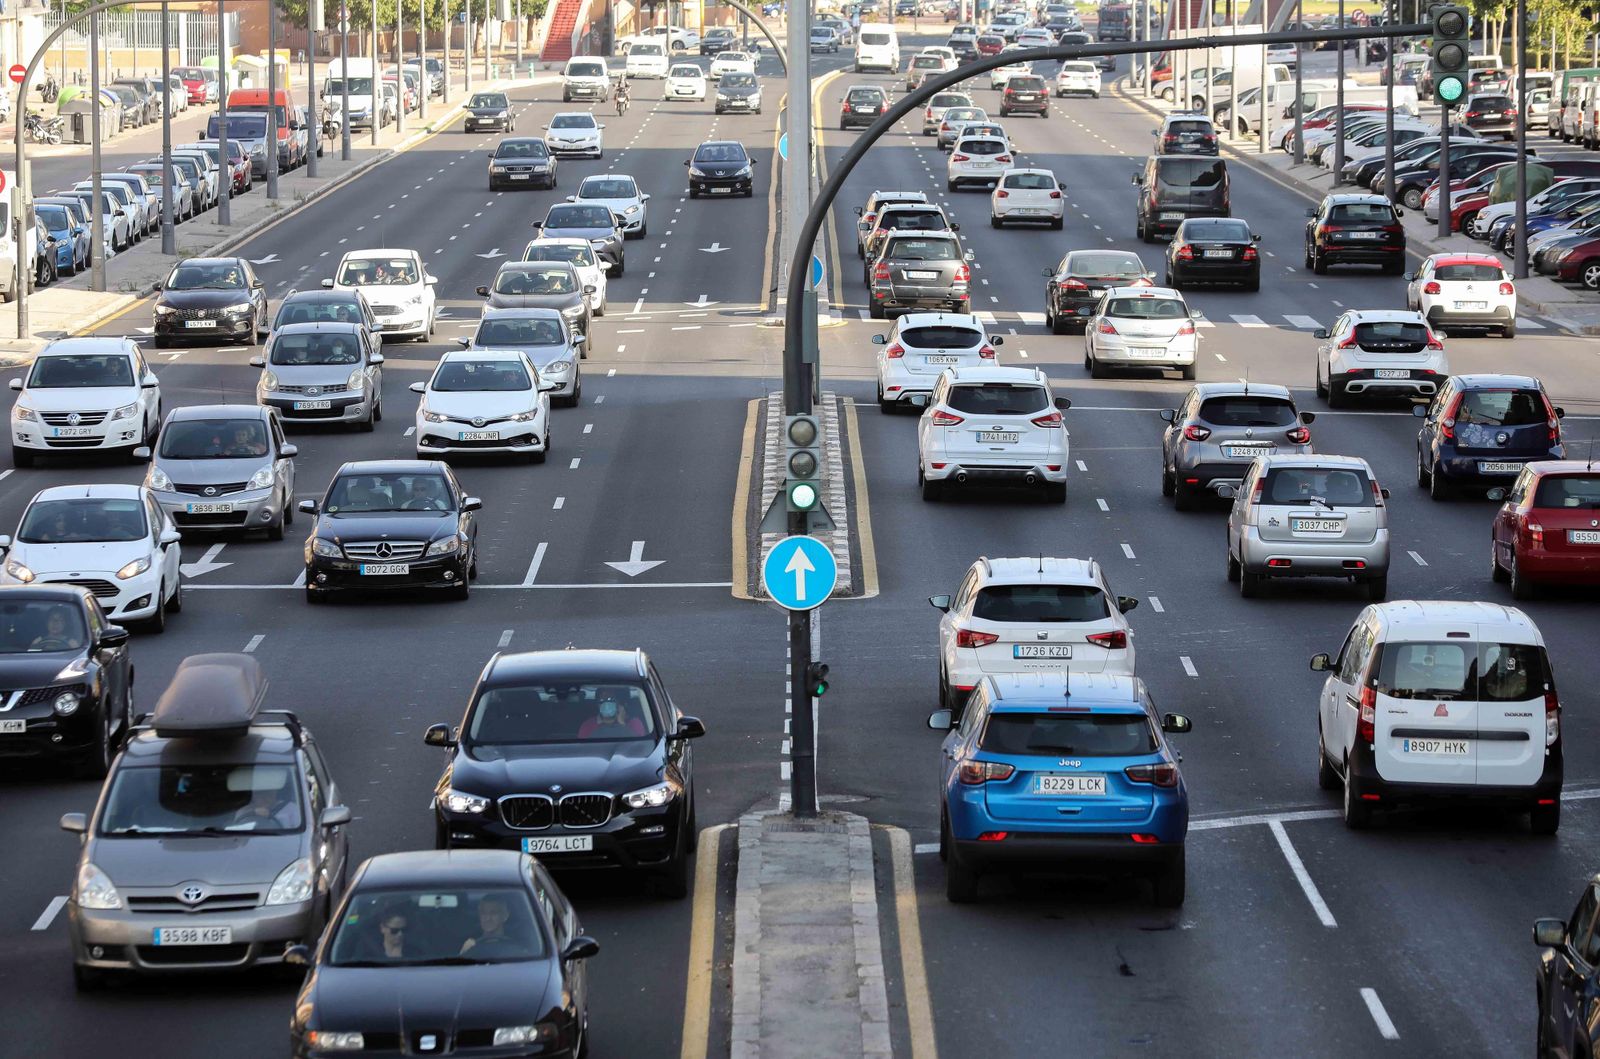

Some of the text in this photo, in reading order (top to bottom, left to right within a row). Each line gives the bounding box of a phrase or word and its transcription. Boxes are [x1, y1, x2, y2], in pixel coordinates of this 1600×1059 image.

[982, 432, 999, 440] 1741
[1576, 532, 1598, 541] 9550
[390, 565, 406, 573] GGK
[1021, 646, 1068, 656] 1736 KZD
[1411, 741, 1466, 753] 8907 HYK
[1059, 759, 1081, 767] Jeep
[1044, 779, 1101, 790] 8229 LCK
[530, 838, 586, 851] 9764 LCT
[163, 929, 227, 942] 3598 KBF
